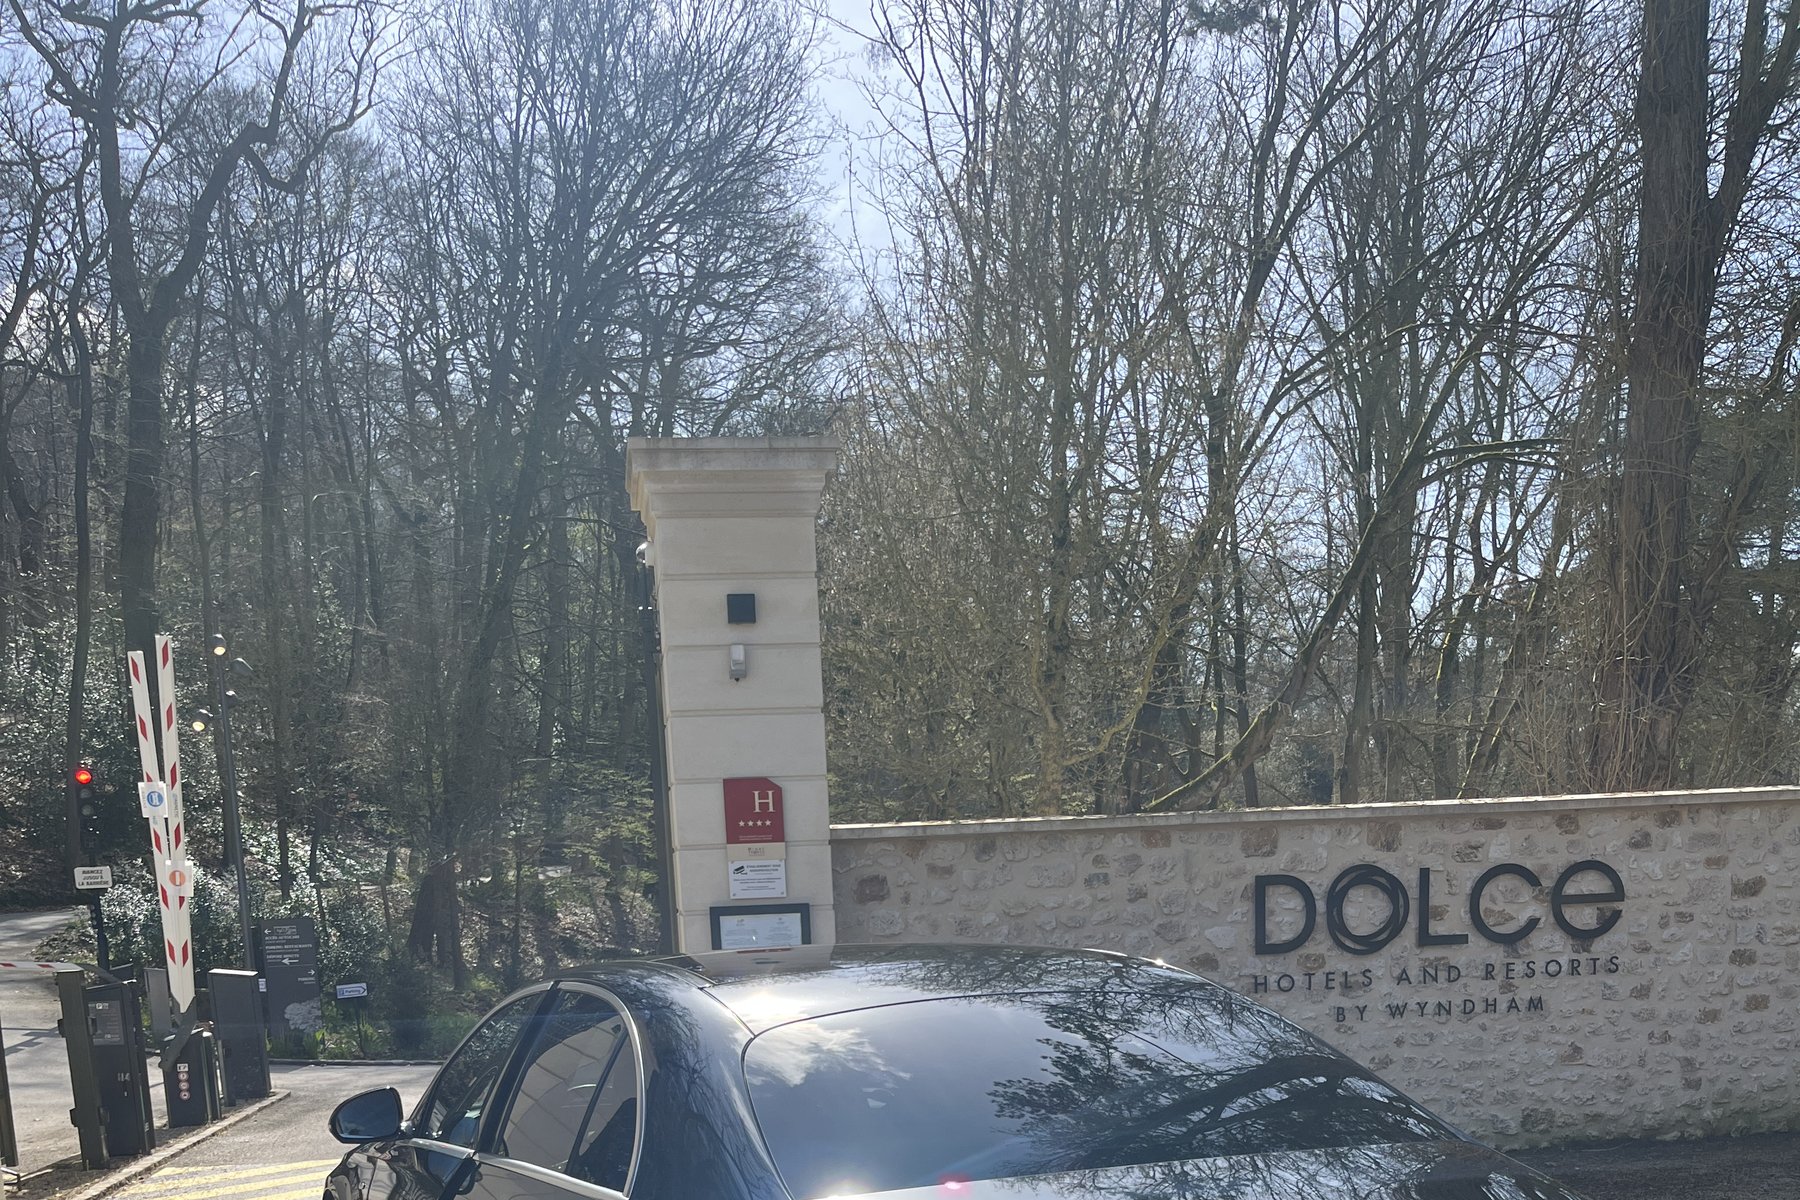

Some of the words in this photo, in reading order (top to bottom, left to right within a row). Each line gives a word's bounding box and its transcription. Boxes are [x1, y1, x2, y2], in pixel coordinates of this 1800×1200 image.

[753, 790, 776, 813] H
[1254, 968, 1373, 994] HOTELS
[1397, 964, 1461, 986] AND
[1485, 956, 1621, 981] RESORTS
[1336, 1004, 1368, 1023] BY
[1389, 995, 1545, 1019] WYNDHAM
